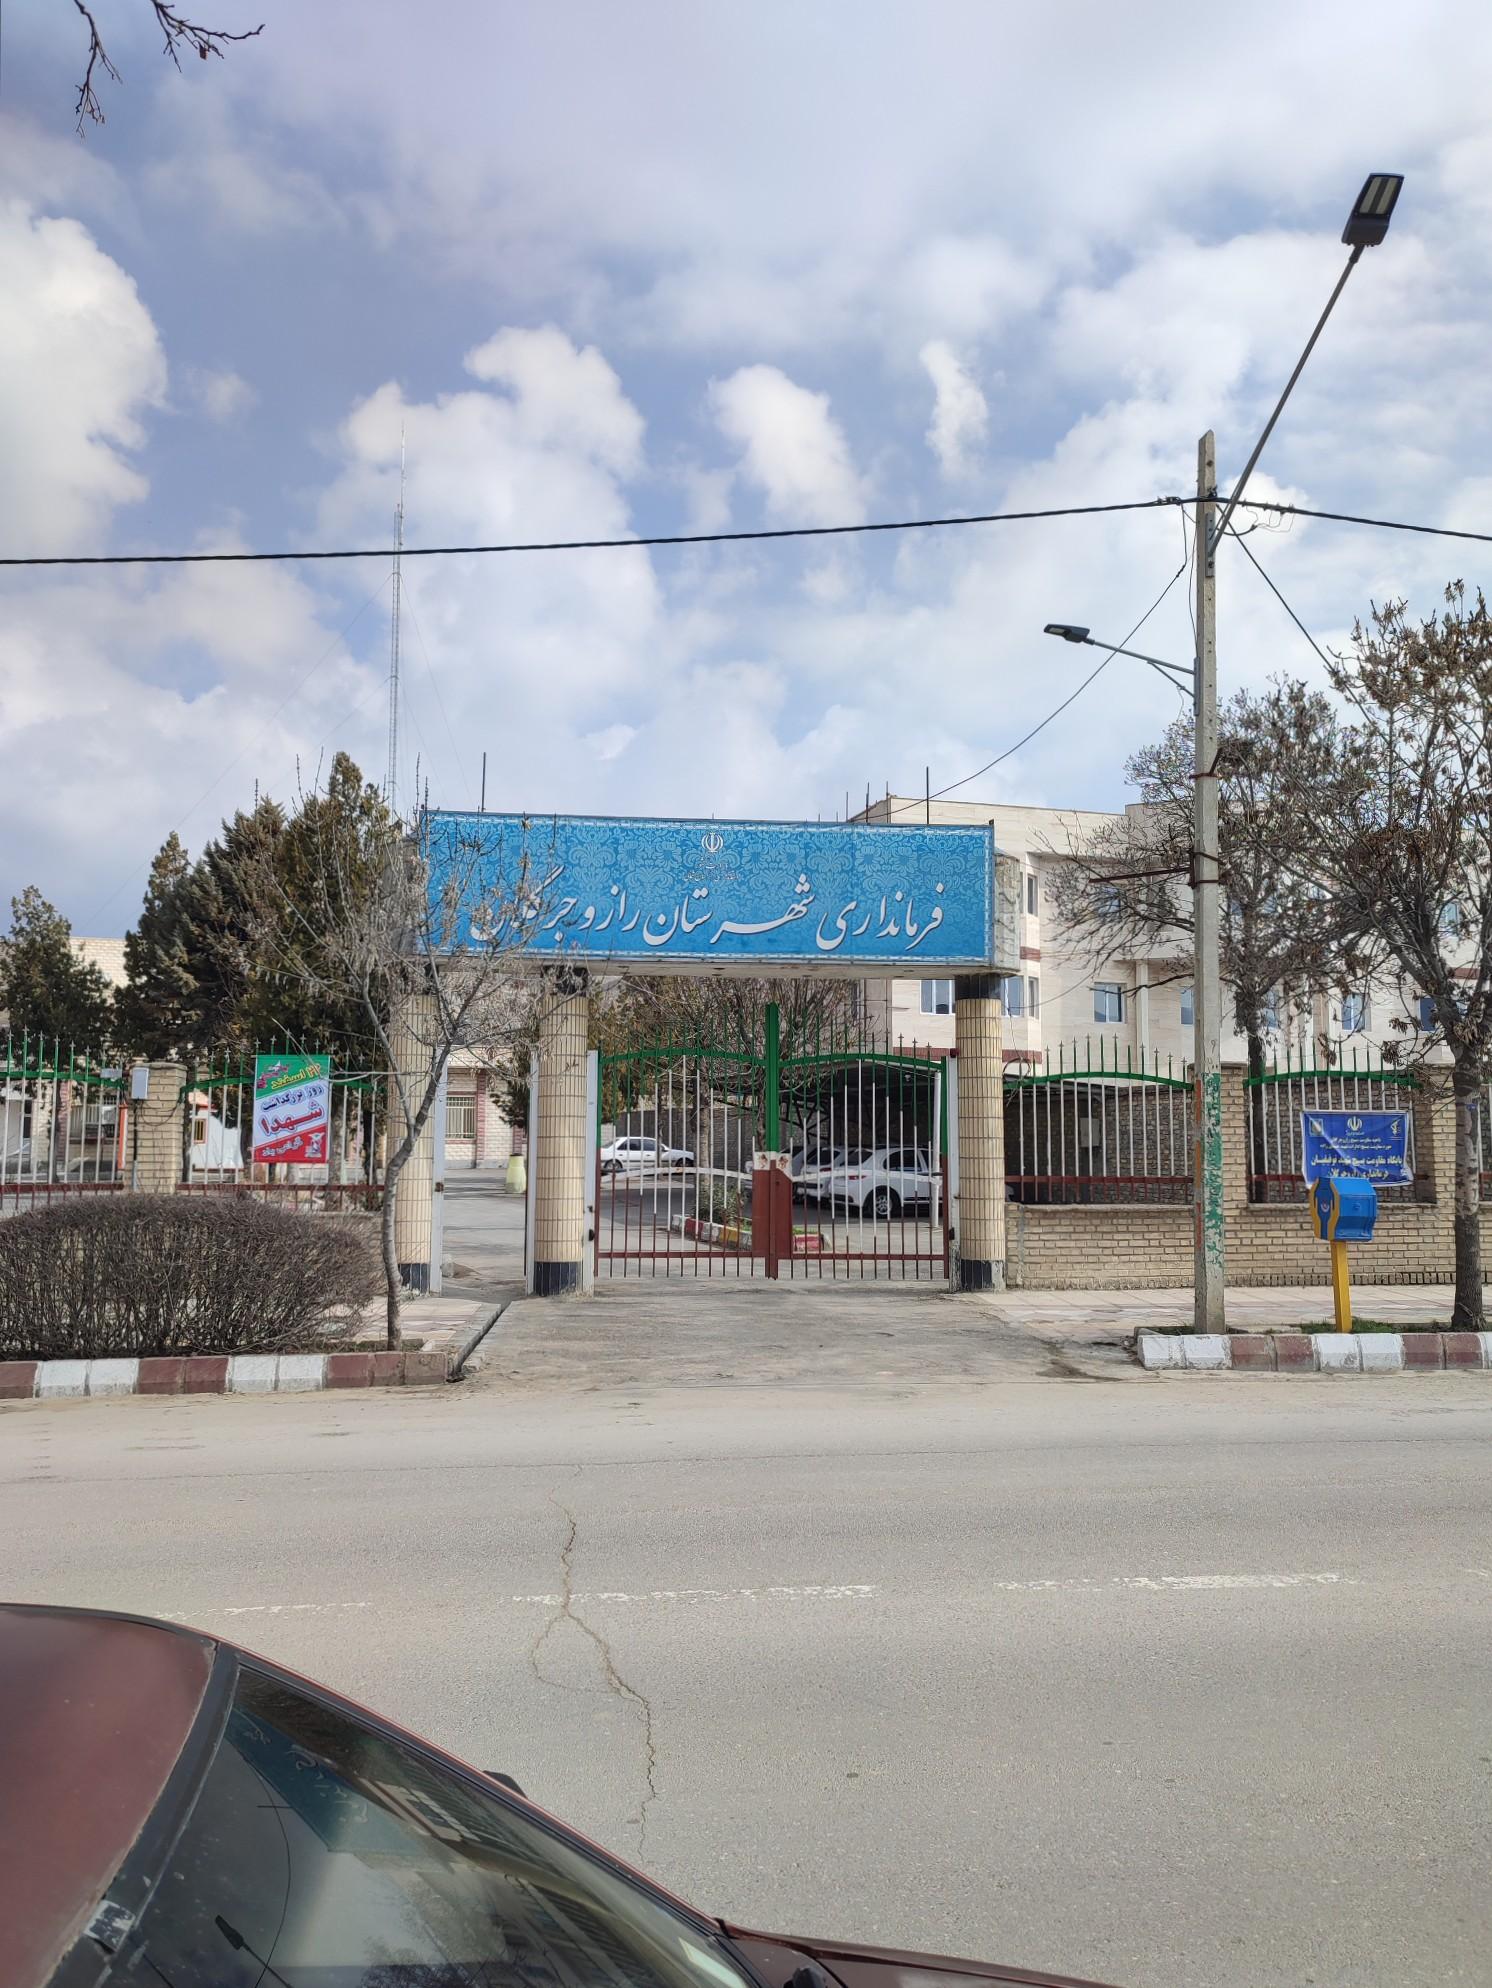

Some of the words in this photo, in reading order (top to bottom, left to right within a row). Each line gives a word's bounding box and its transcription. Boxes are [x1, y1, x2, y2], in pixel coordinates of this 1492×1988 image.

[595, 884, 641, 932] راز
[642, 873, 816, 947] شهرستان
[815, 882, 945, 951] فرمانداری
[271, 1069, 306, 1090] اسفند
[307, 1086, 323, 1098] روز
[262, 1089, 303, 1111] بزرگداشت
[261, 1101, 324, 1134] شهدا
